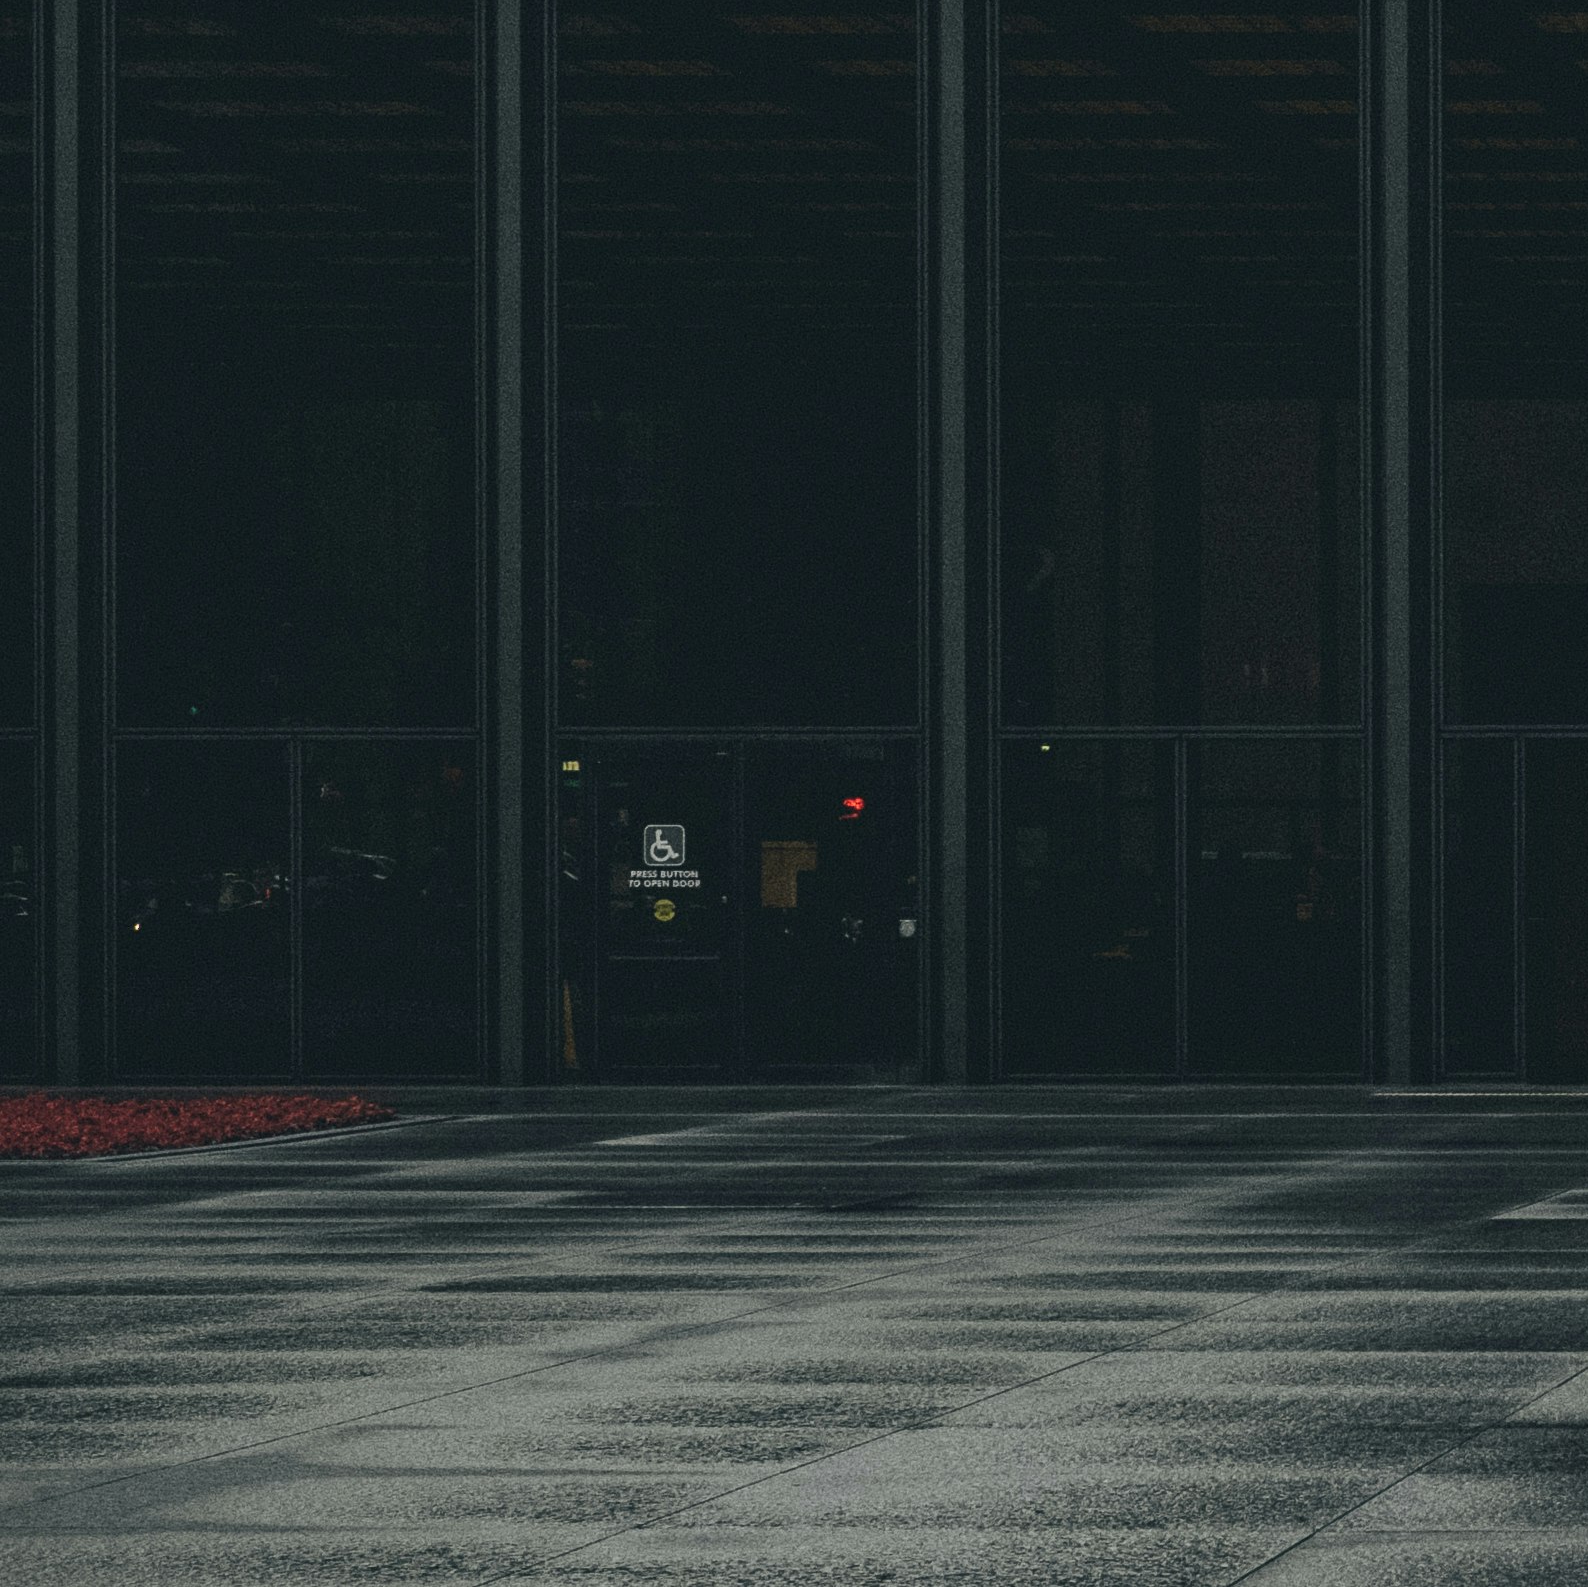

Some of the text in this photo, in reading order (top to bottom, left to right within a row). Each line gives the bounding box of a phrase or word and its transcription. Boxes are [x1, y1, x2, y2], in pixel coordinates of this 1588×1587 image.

[630, 870, 698, 878] PRESS BUTTON
[628, 879, 701, 888] TO OPEN DOOR
